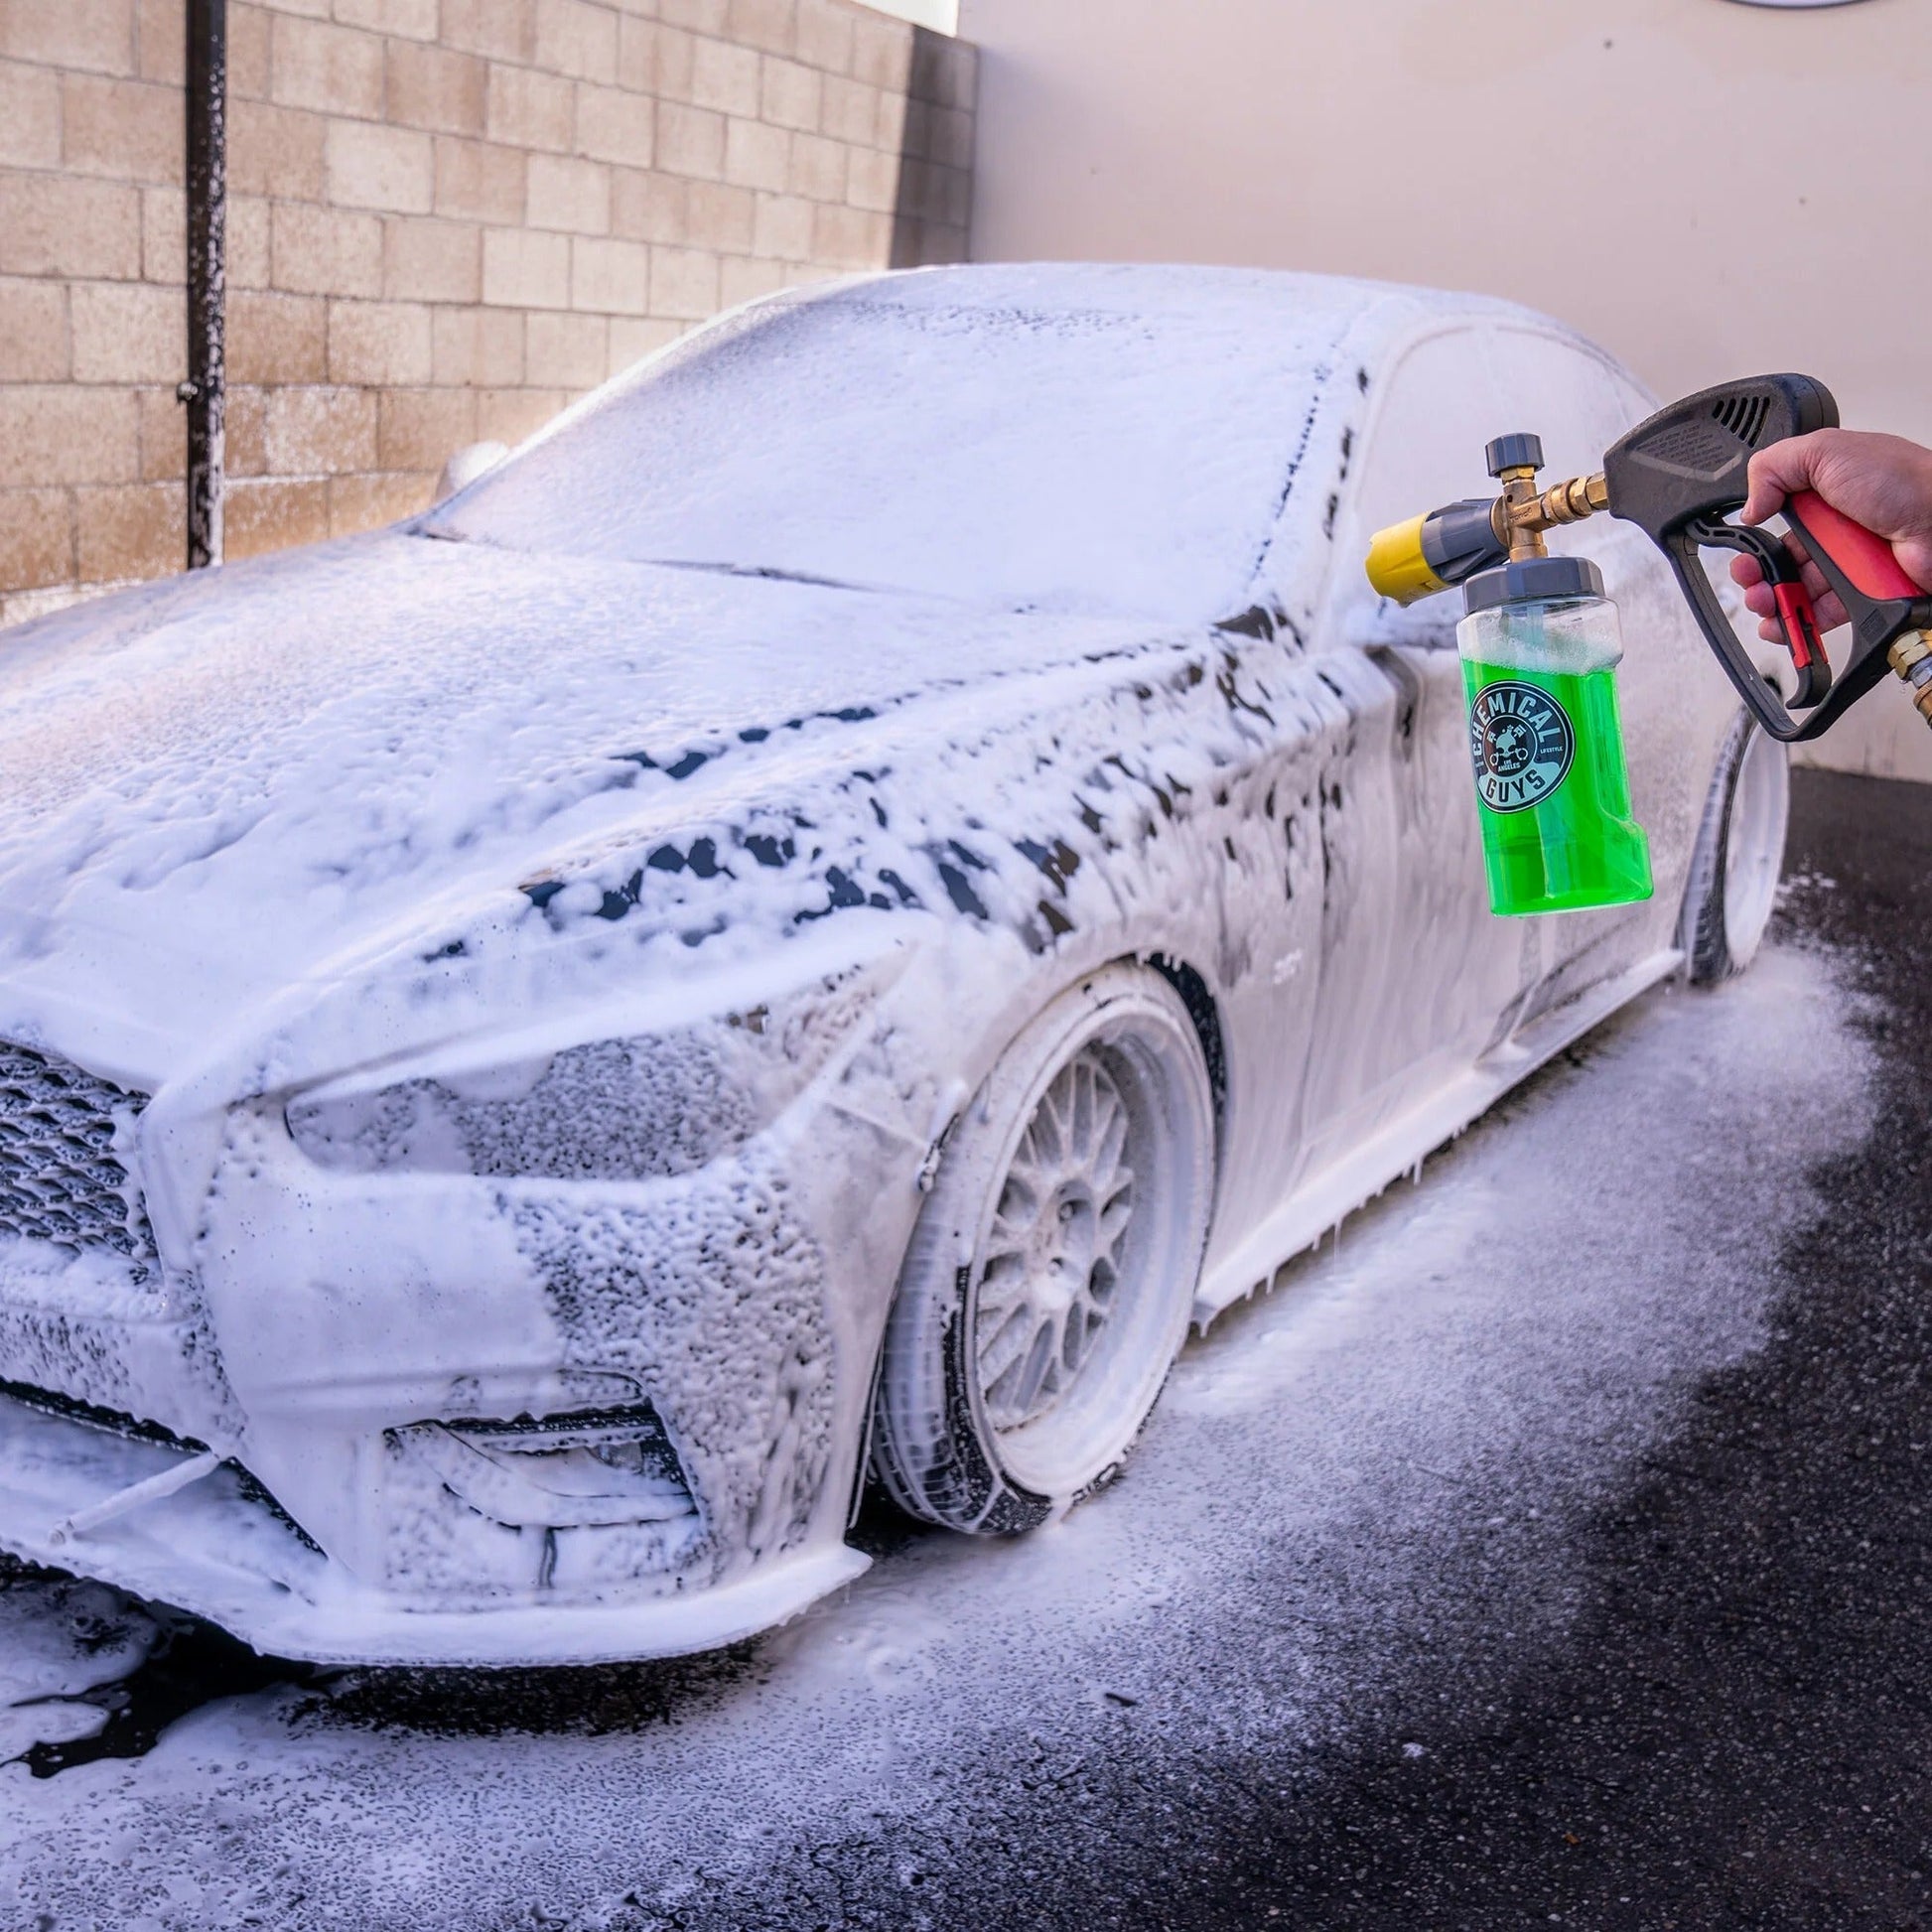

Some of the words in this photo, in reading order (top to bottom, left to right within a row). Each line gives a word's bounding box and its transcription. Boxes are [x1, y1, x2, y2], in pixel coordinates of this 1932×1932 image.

[1472, 692, 1561, 757] CHEMICAL
[1540, 746, 1564, 755] LIFESTYLE
[1497, 762, 1521, 772] ANGELES
[1486, 768, 1546, 803] GUYS
